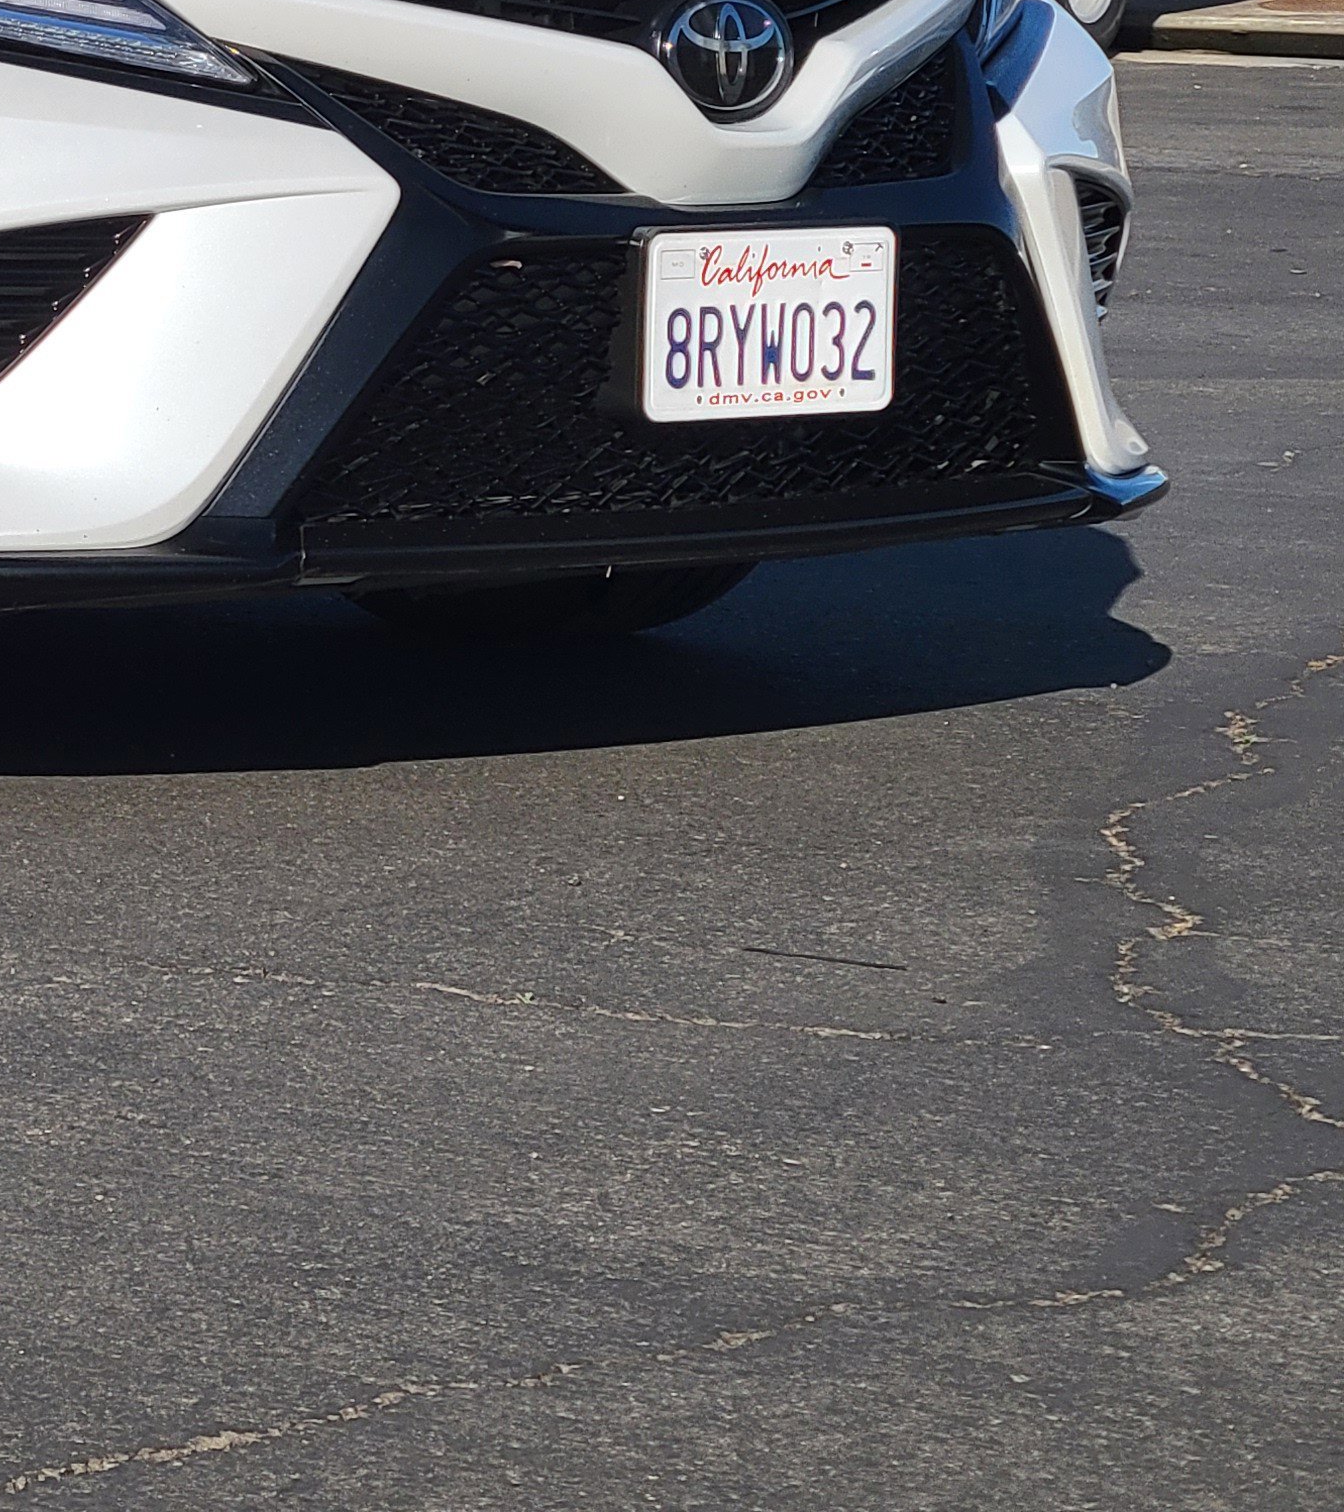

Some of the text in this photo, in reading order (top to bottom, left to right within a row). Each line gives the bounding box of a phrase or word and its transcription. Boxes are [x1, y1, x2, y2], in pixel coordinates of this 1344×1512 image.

[701, 244, 851, 297] California
[666, 300, 877, 389] 8RYW032
[709, 389, 832, 406] dmv.ca.gov
